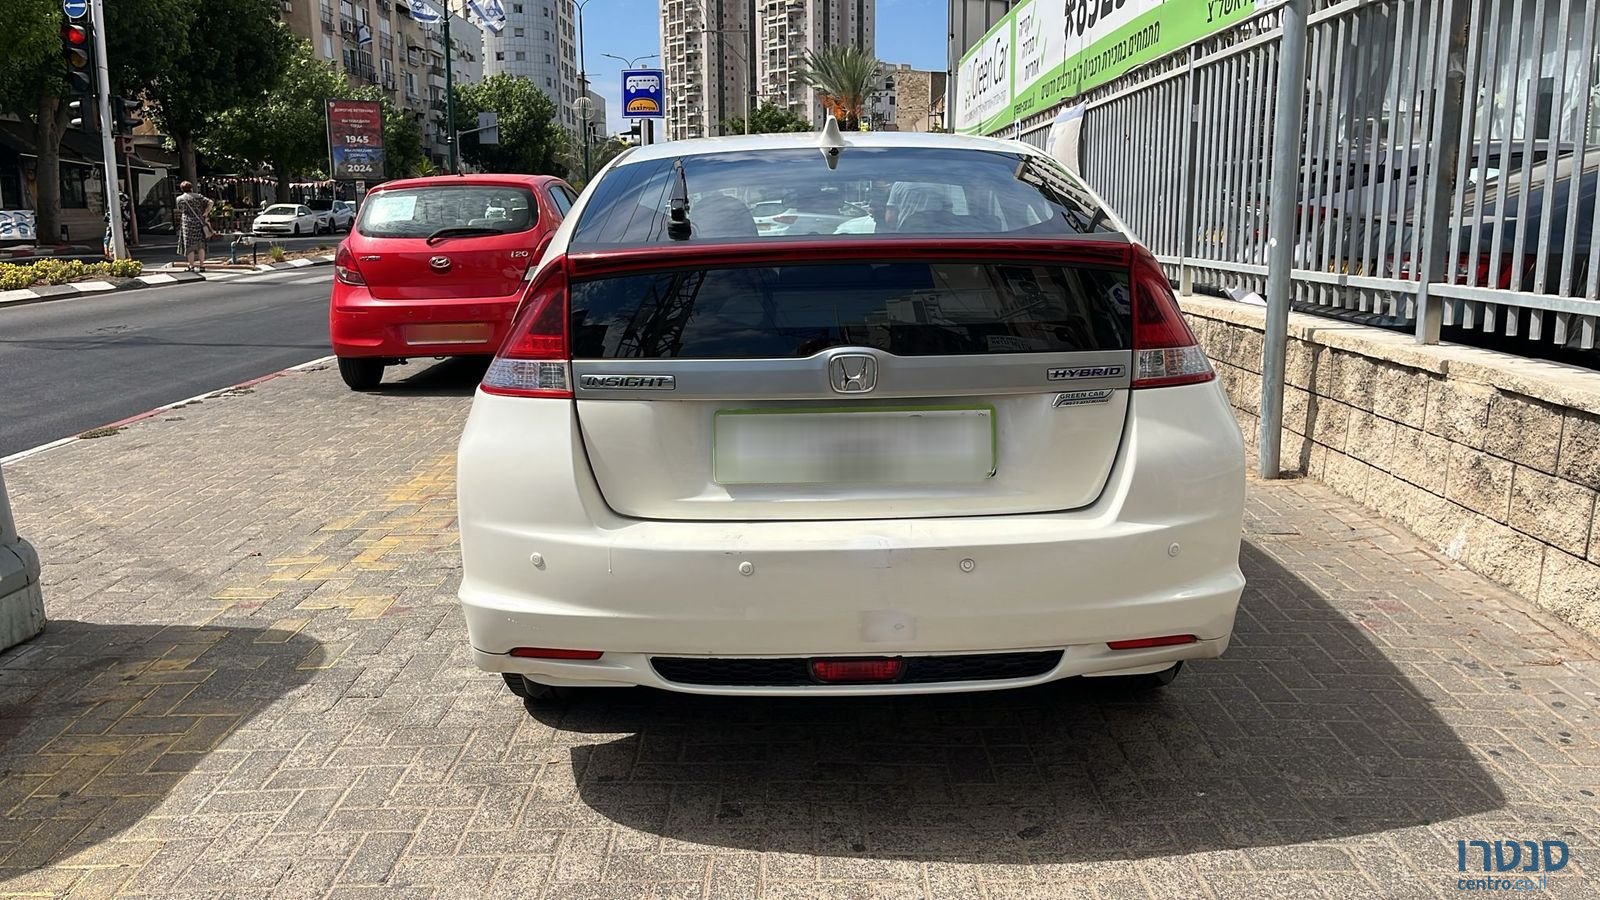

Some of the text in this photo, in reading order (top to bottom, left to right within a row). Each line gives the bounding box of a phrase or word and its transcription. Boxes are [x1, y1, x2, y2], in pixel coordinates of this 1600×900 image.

[1128, 21, 1160, 57] מתמחים
[994, 37, 1009, 85] Car
[345, 135, 369, 143] 1945
[347, 164, 373, 173] 2024
[1050, 367, 1121, 378] HYBRID
[586, 377, 672, 387] INSIGHT
